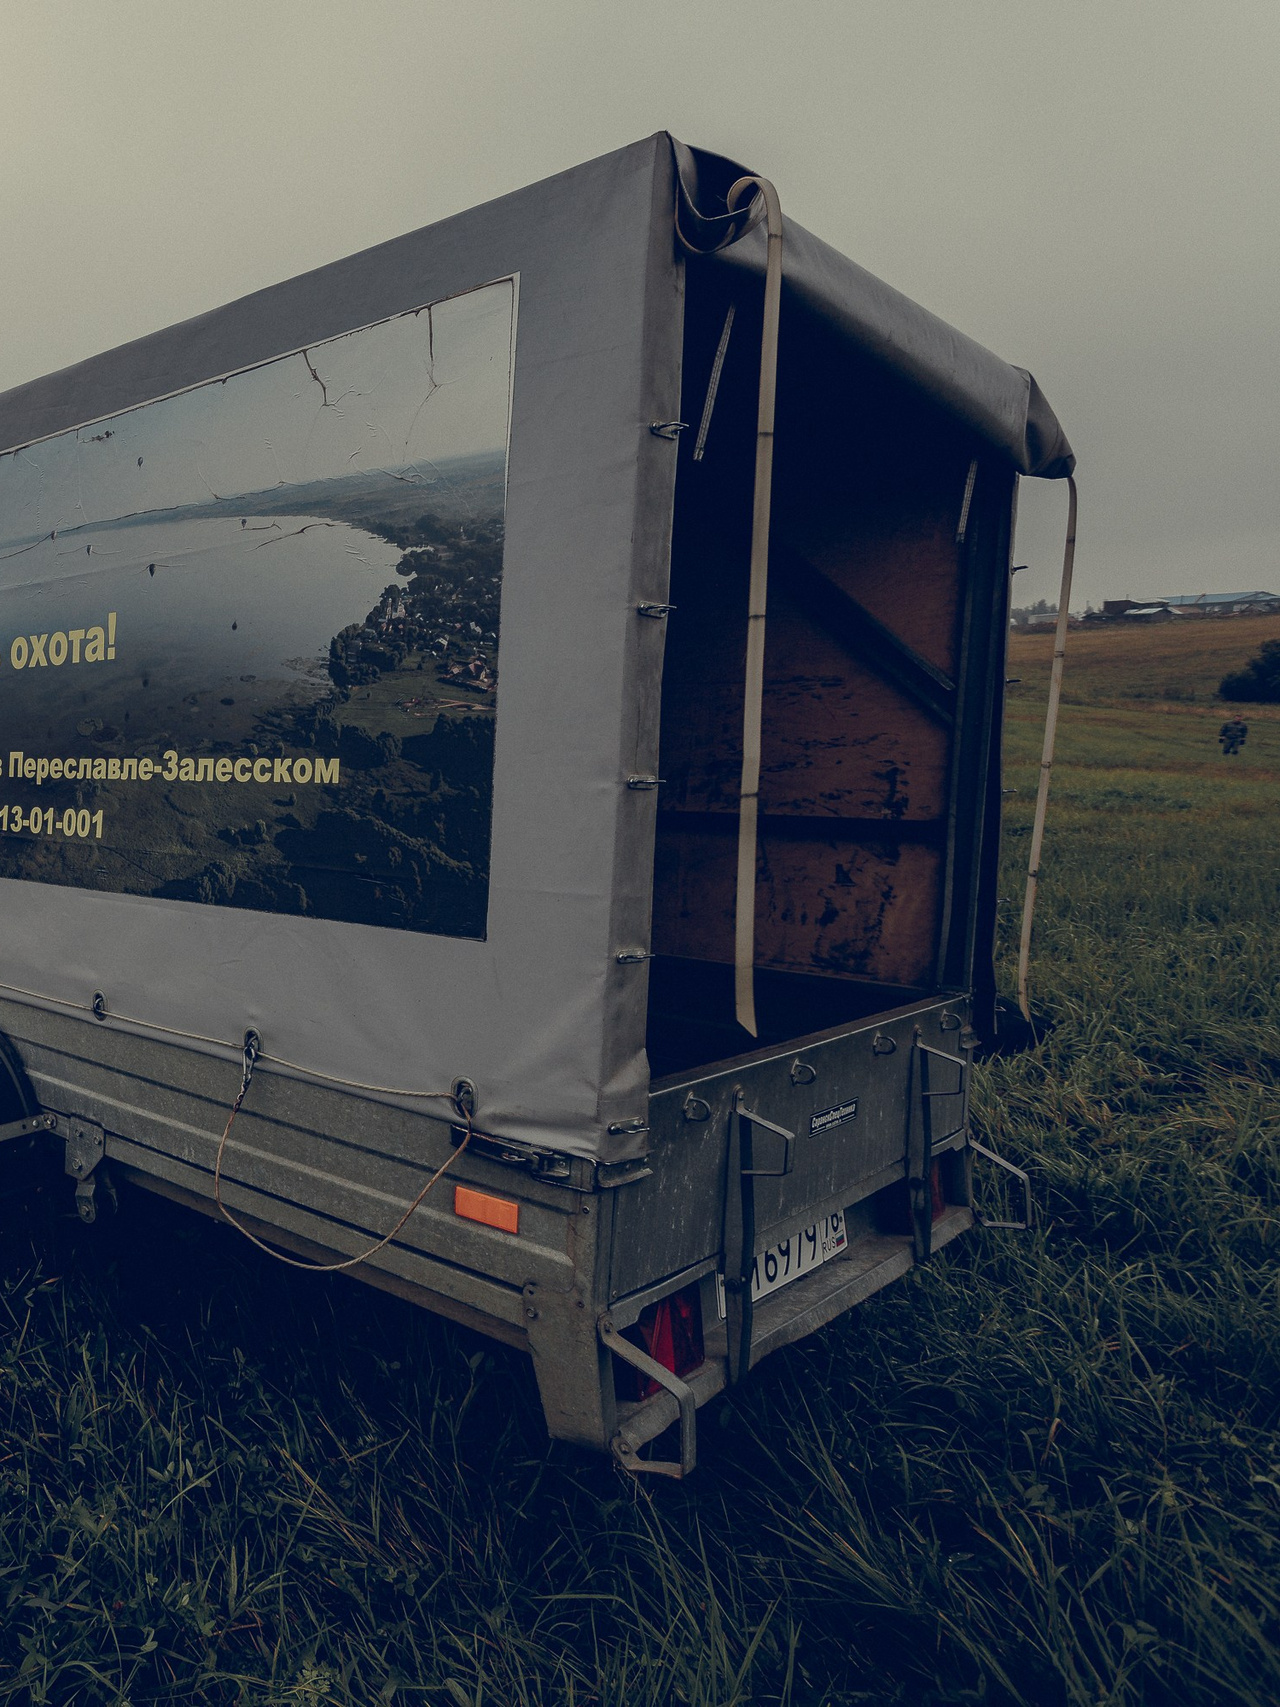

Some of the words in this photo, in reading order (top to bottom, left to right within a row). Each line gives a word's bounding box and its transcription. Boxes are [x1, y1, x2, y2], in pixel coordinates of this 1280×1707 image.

[10, 611, 118, 670] охота!
[8, 750, 340, 785] Переславле-Залесском
[822, 1236, 836, 1253] RUS
